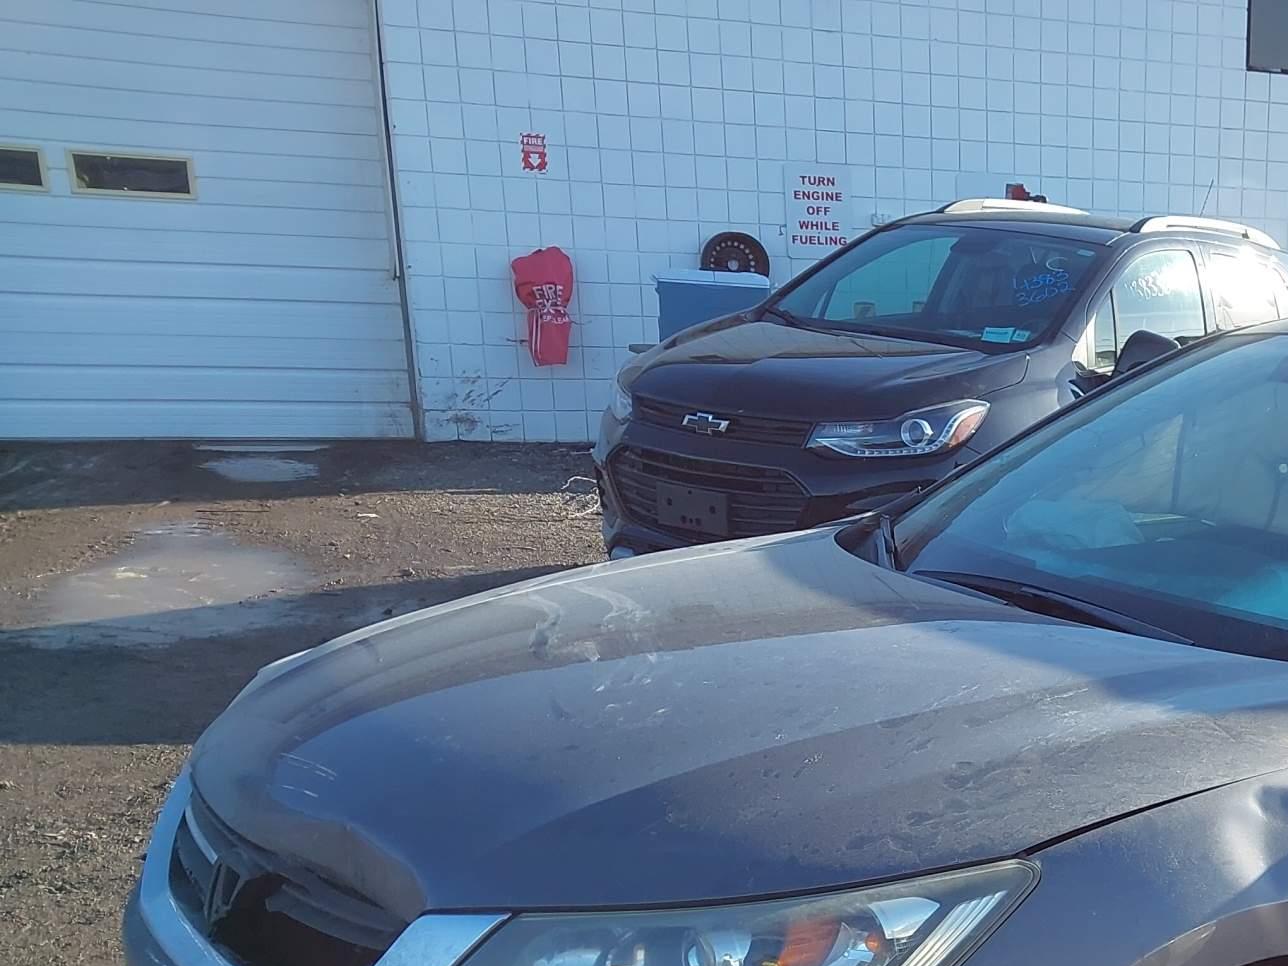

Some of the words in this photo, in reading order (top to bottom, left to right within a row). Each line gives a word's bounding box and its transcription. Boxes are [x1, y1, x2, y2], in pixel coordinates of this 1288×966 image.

[523, 137, 543, 145] FIRE
[799, 175, 835, 186] TURN
[793, 190, 843, 202] ENGINE
[806, 205, 831, 216] OFF
[798, 220, 840, 231] WHILE
[792, 234, 848, 246] FUELING
[532, 284, 564, 300] FIRE
